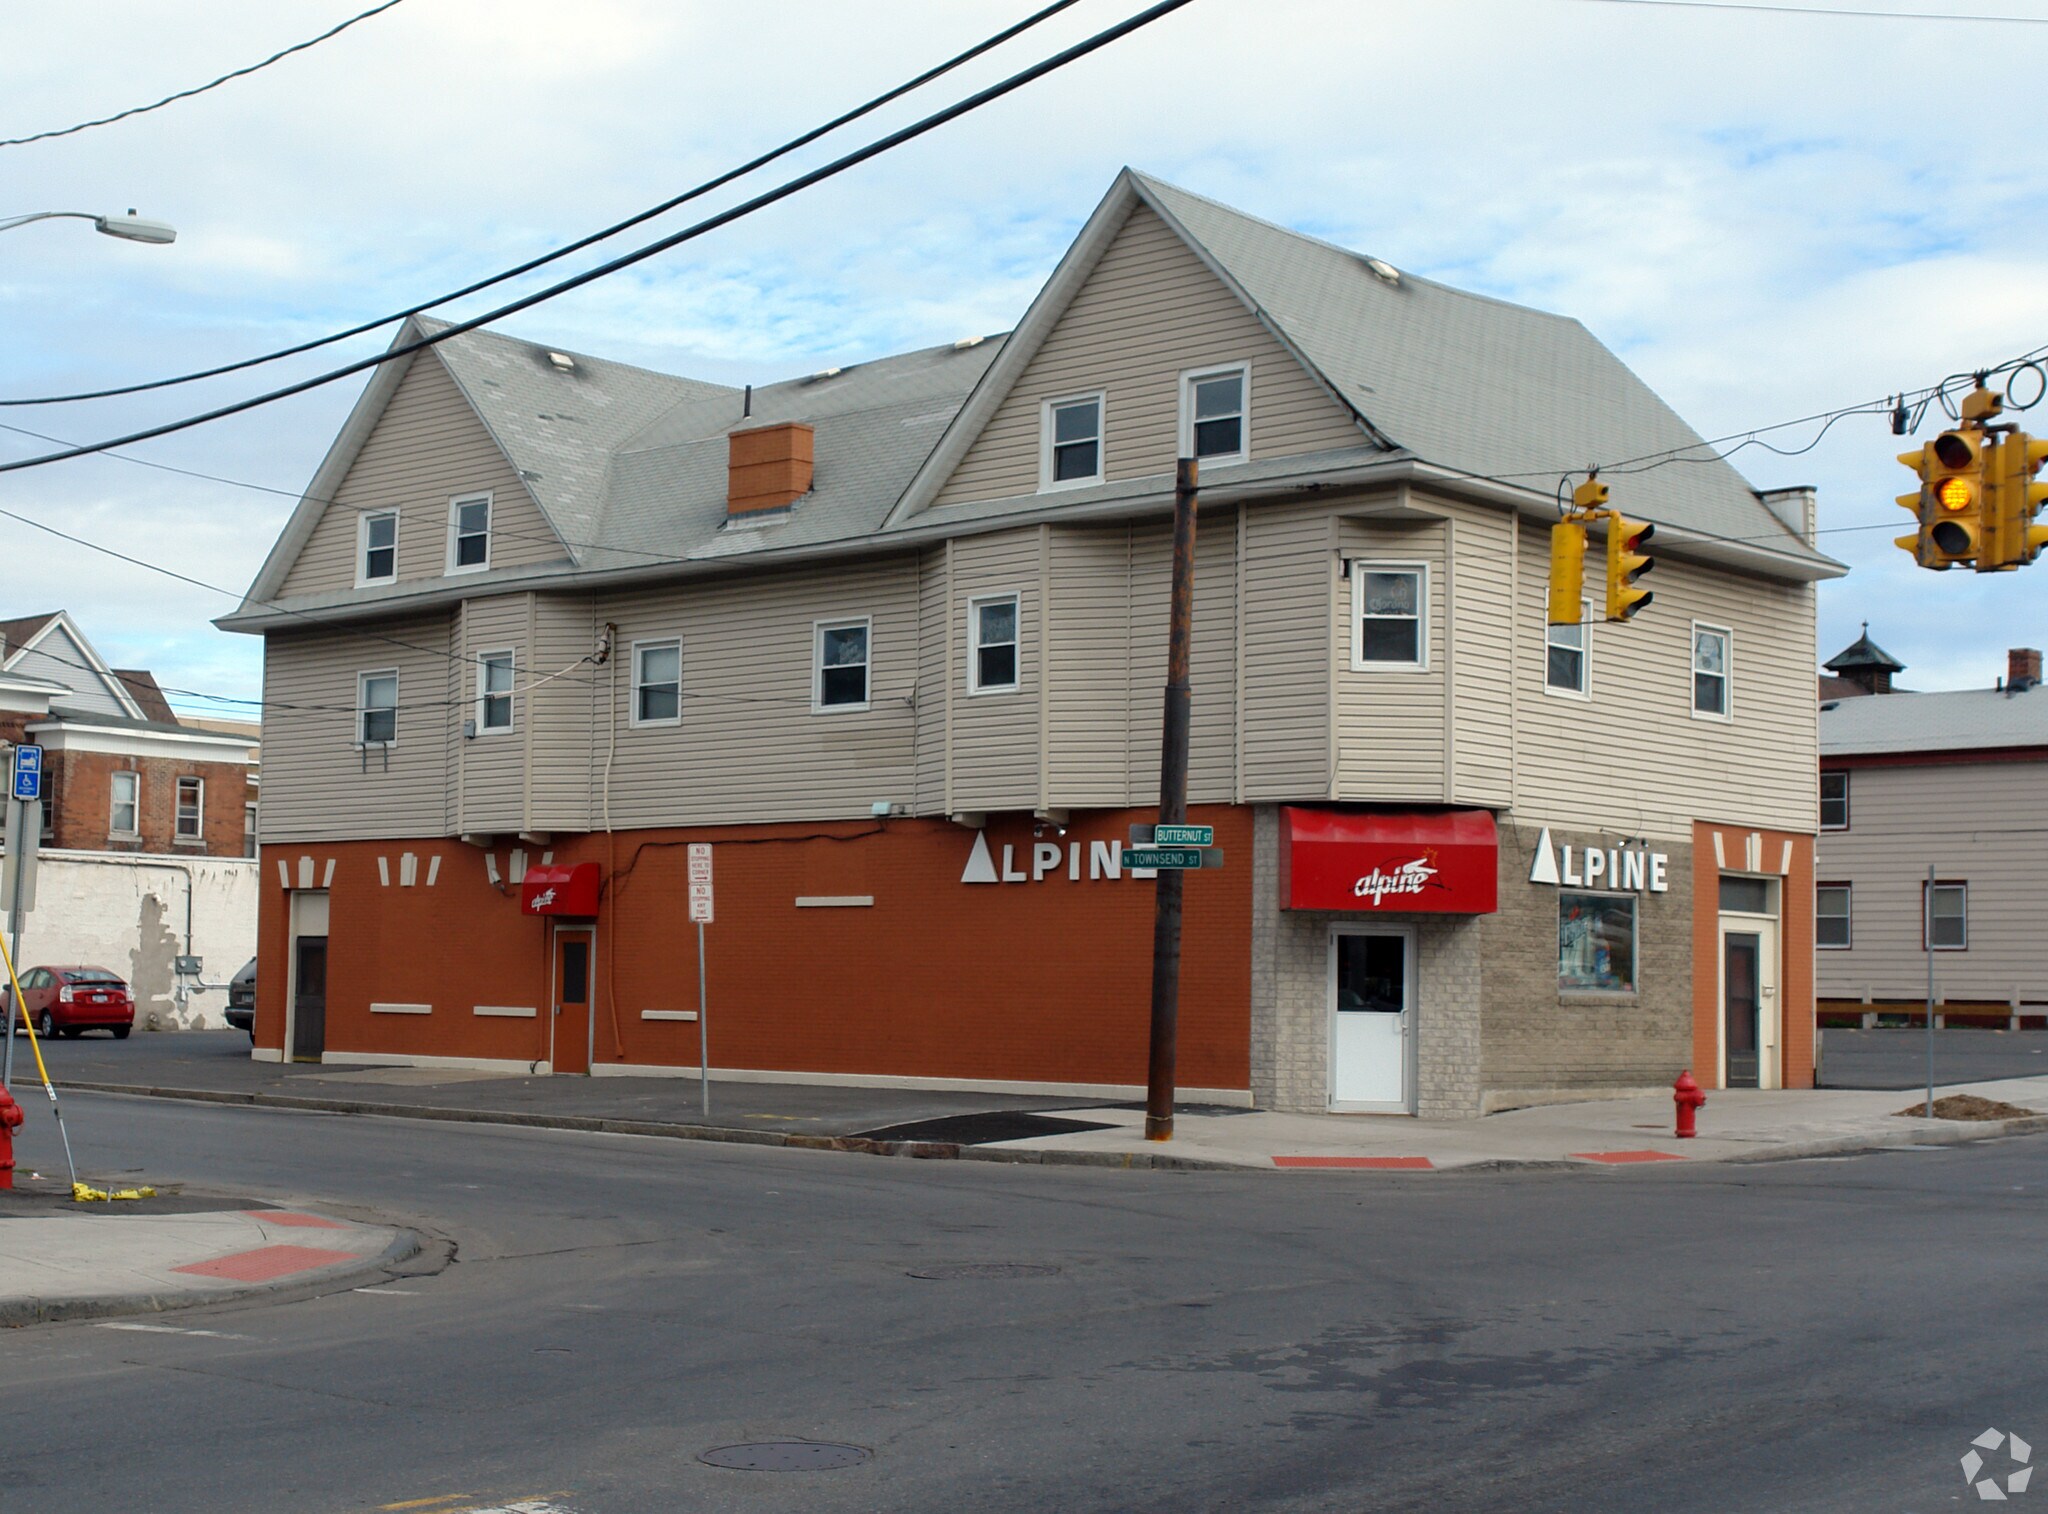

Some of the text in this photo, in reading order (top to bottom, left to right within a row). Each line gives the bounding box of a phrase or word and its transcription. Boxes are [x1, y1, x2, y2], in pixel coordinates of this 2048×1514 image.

[1157, 829, 1212, 842] BUTTERNUT ST
[696, 847, 706, 855] NO
[1124, 853, 1198, 865] N TOWNSEND ST
[1530, 826, 1668, 892] ALPINE
[1354, 857, 1438, 907] alpine
[696, 887, 706, 895] NO
